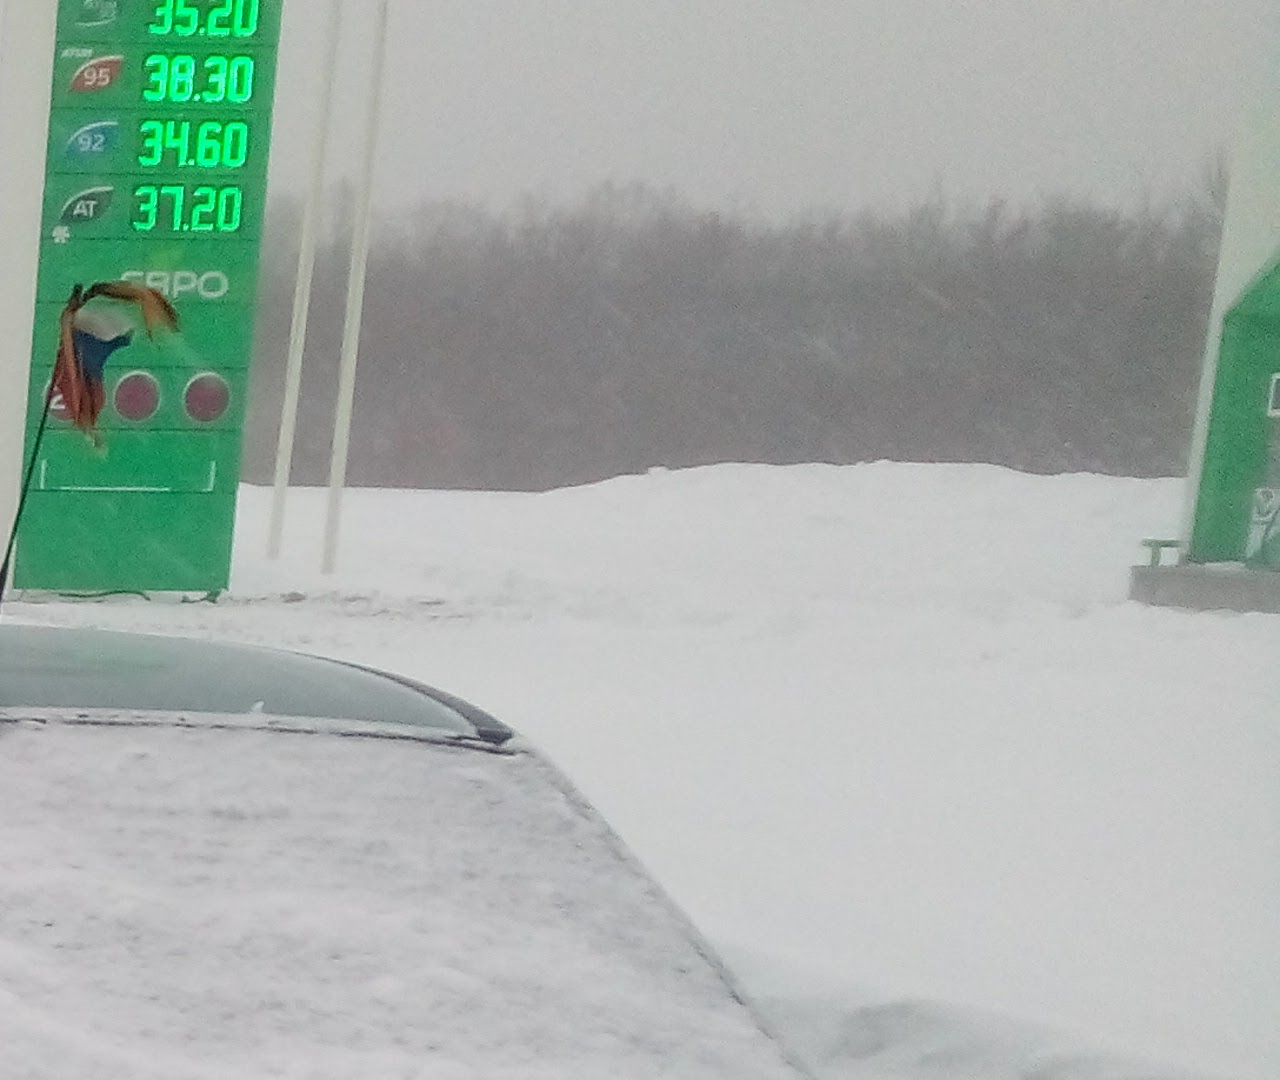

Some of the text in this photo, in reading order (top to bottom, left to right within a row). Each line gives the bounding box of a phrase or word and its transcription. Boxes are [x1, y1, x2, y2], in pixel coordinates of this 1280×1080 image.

[148, 0, 259, 36] 35.20
[83, 54, 254, 102] 95 38.30
[78, 120, 248, 167] 92 34.60
[133, 186, 242, 231] 37.20
